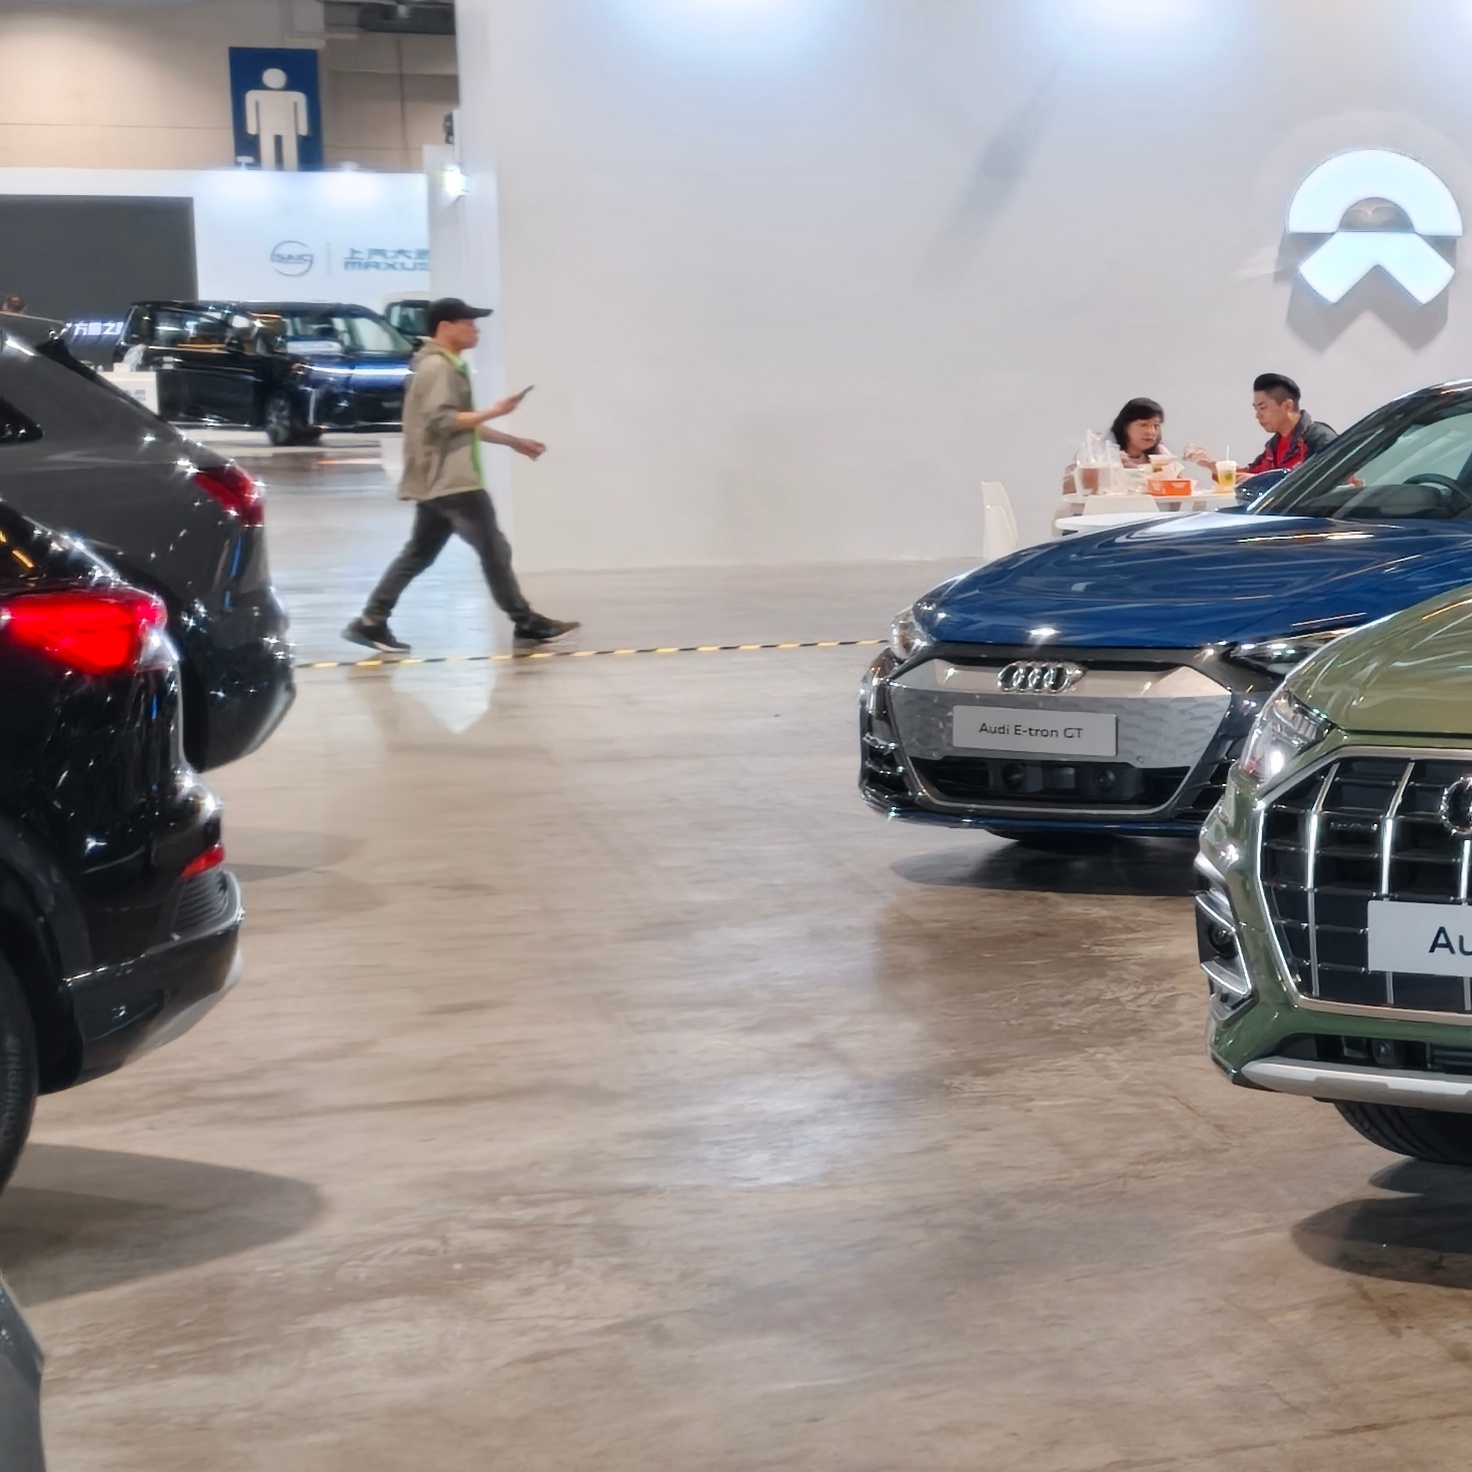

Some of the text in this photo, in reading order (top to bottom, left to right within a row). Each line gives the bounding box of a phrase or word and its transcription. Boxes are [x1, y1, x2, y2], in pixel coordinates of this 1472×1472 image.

[979, 723, 1083, 738] Audi E-tron GT
